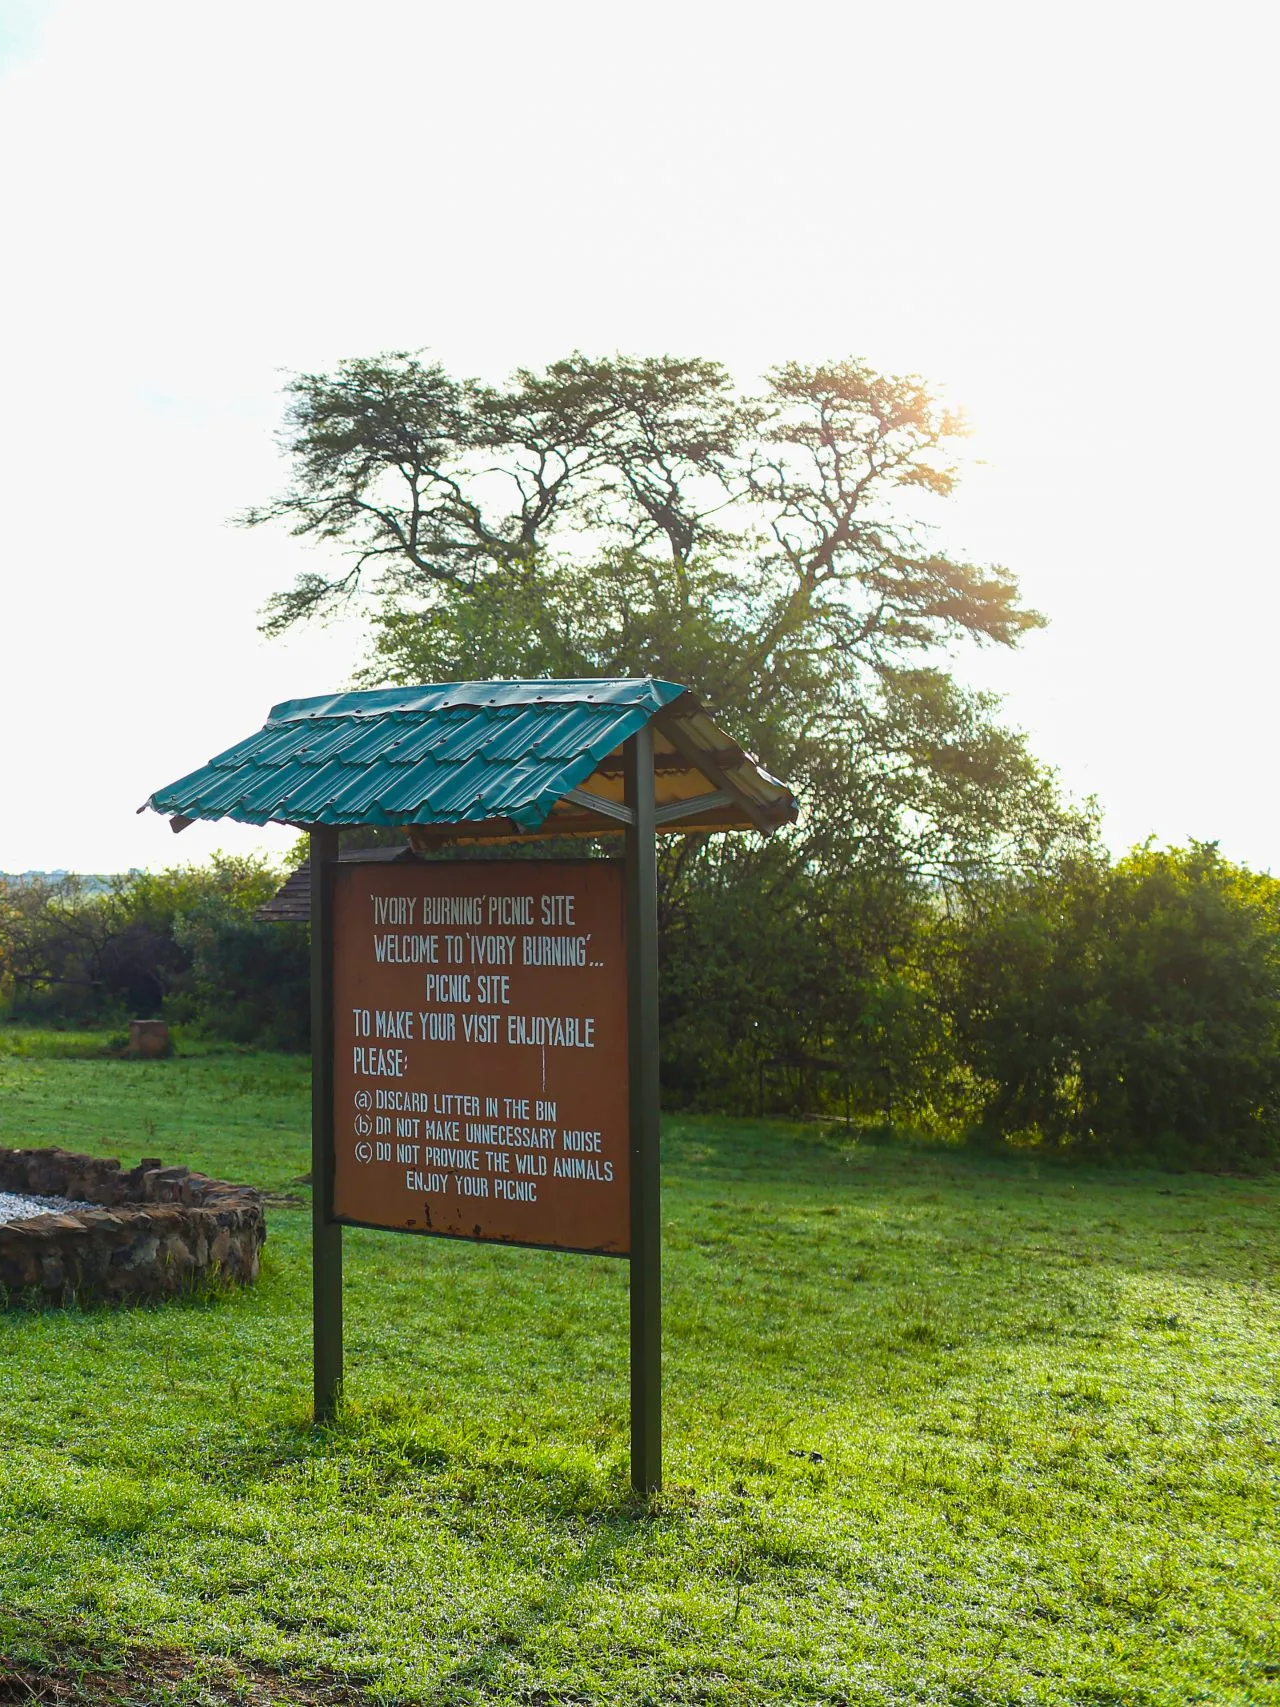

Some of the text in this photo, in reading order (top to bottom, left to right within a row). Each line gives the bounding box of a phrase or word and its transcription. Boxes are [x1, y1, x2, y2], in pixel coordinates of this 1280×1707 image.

[489, 897, 534, 925] PICNIC
[542, 896, 575, 925] SITE
[374, 935, 438, 963] WELCOME
[445, 935, 462, 964] TO
[426, 974, 509, 1003] PICNIC SITE
[353, 1009, 594, 1047] TO MAKE YOUR VISIT ENJOYABLE
[355, 1090, 556, 1122] (a) DISCARD LITTER IN THE BIN
[355, 1115, 601, 1152] (b) DO NOT MAKE UNNECESSARY NOISE
[355, 1141, 613, 1182] (c) DO NOT PROVOKE THE WILD ANIMALS
[406, 1171, 537, 1202] ENJOY YOUR PICNIC
